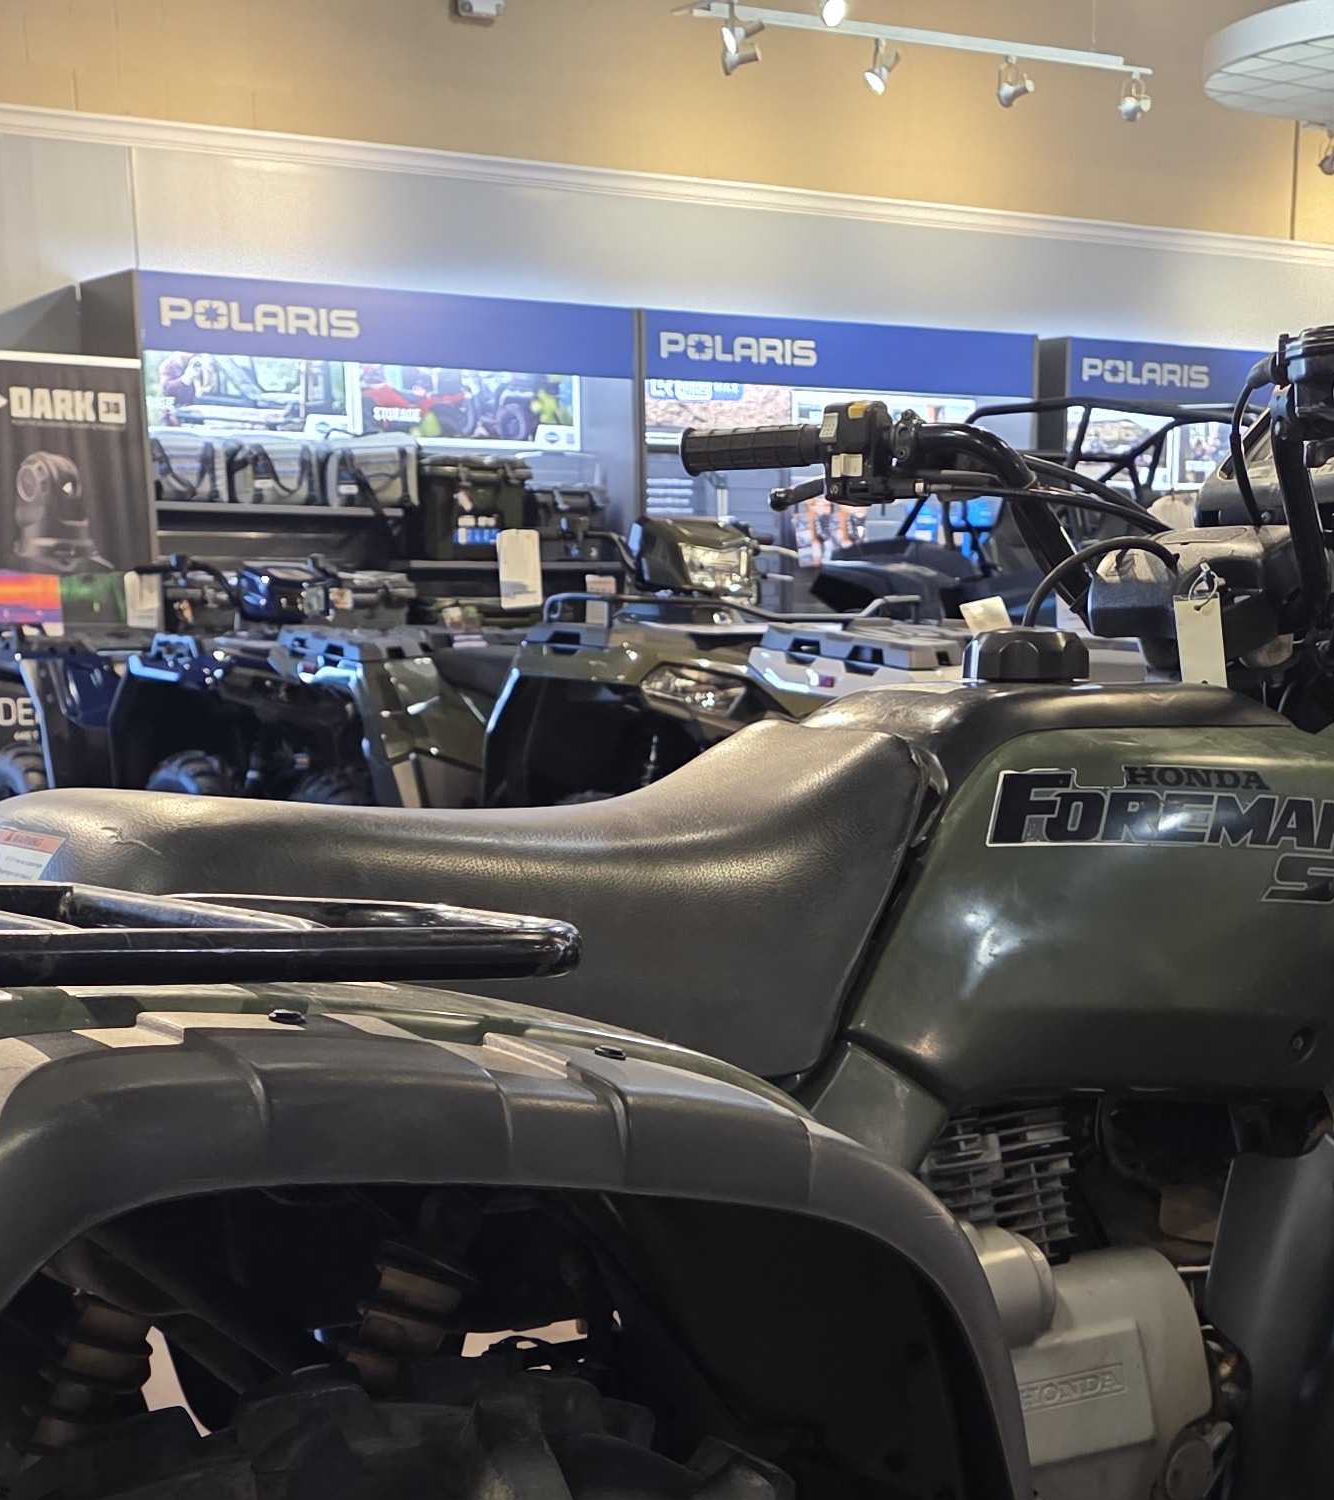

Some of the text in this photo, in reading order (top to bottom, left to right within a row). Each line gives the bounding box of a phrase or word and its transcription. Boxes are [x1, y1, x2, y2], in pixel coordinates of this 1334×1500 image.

[159, 296, 361, 339] POLARIS
[659, 331, 817, 368] POLARIS
[1082, 357, 1210, 389] POLARIS
[9, 386, 96, 422] DARK
[1125, 766, 1270, 791] HONDA
